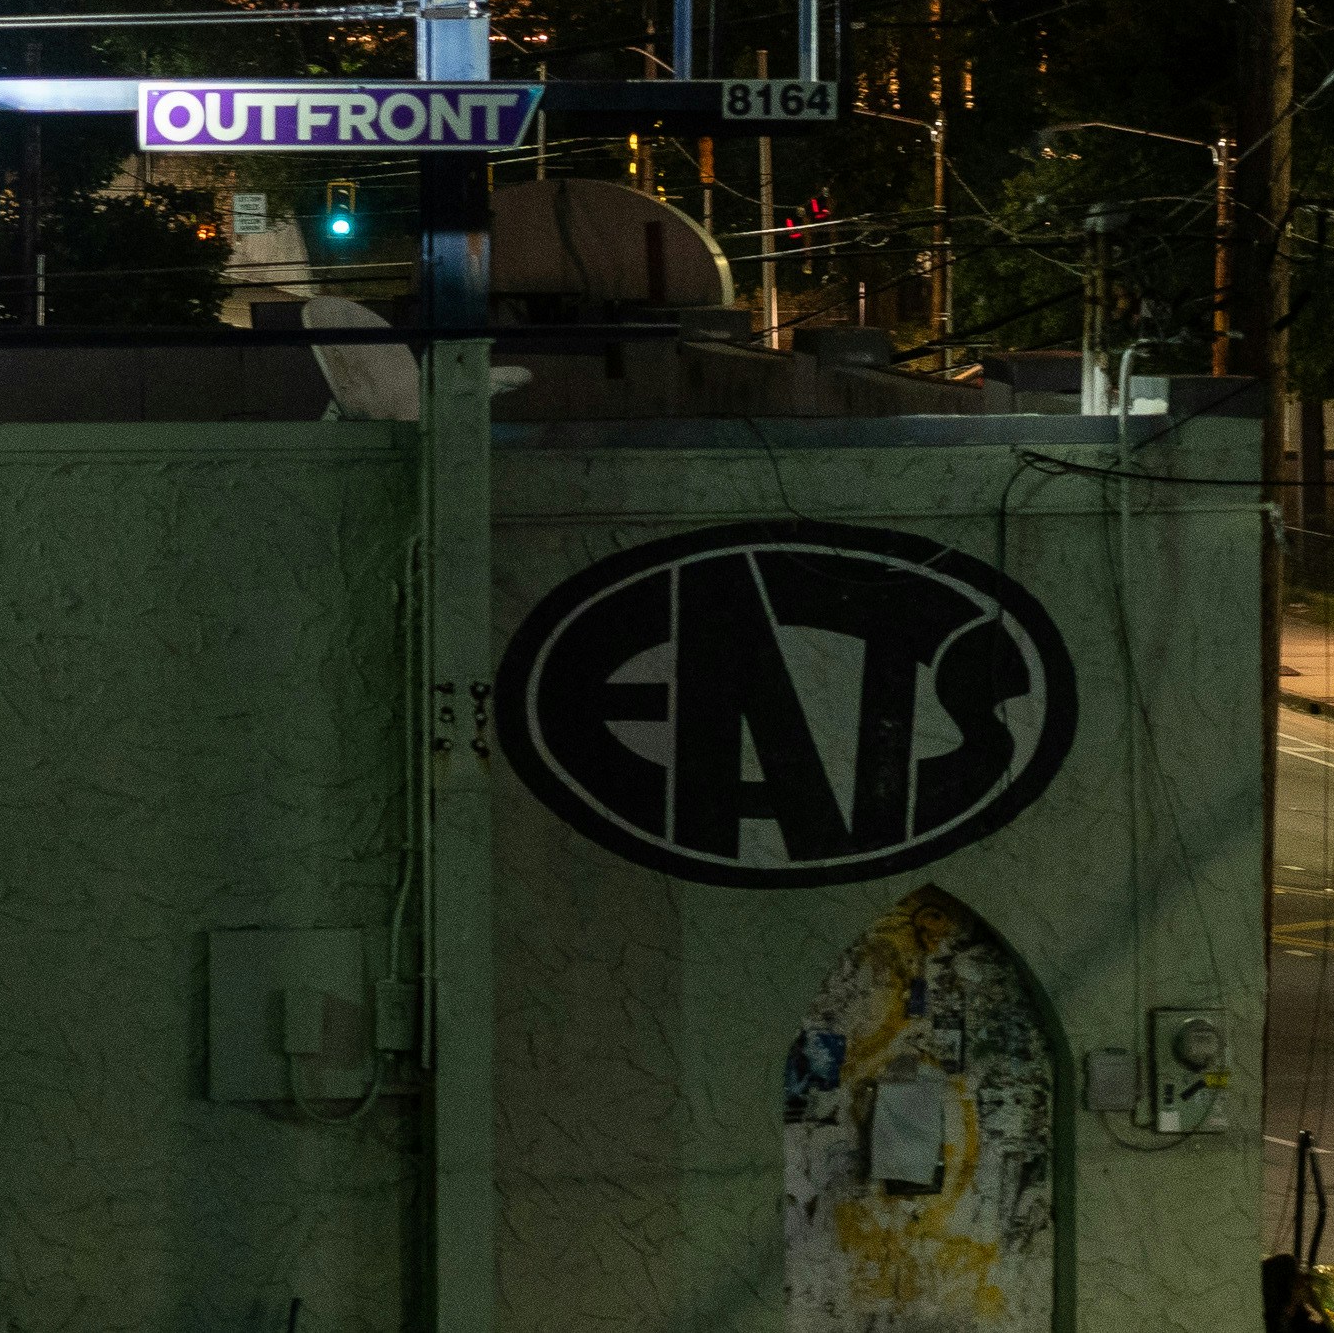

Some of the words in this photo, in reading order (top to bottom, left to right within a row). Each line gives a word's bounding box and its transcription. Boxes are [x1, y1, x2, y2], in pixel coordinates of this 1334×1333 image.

[152, 90, 519, 143] OUTFRONT
[725, 83, 833, 117] 8164
[535, 549, 1034, 863] EATS
